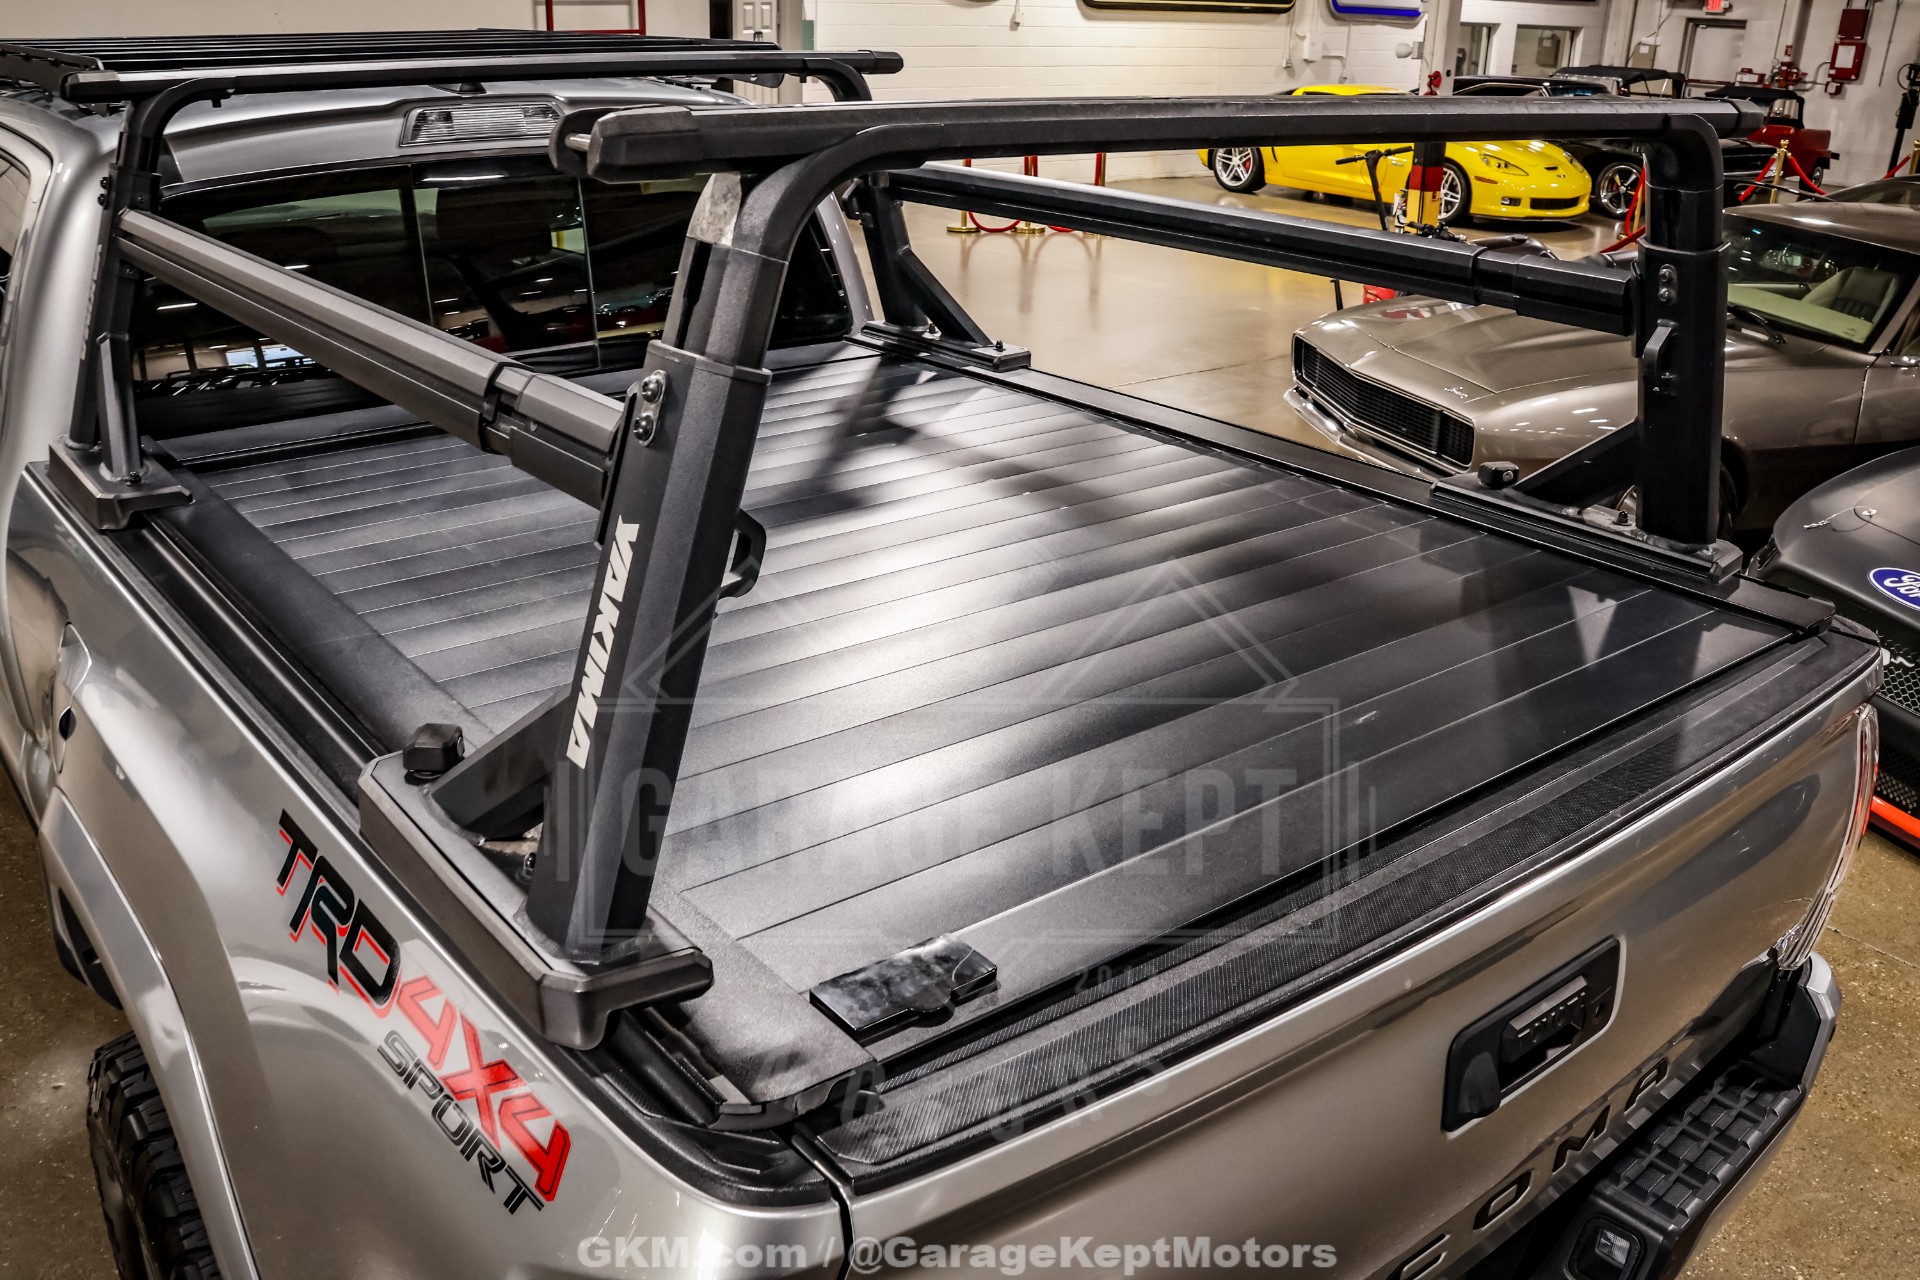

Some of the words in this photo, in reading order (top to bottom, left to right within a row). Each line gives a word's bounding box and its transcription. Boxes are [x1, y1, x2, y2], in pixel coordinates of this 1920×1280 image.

[566, 515, 640, 770] YAKIMA
[276, 808, 402, 1018] TRD
[377, 1030, 544, 1215] SPORT
